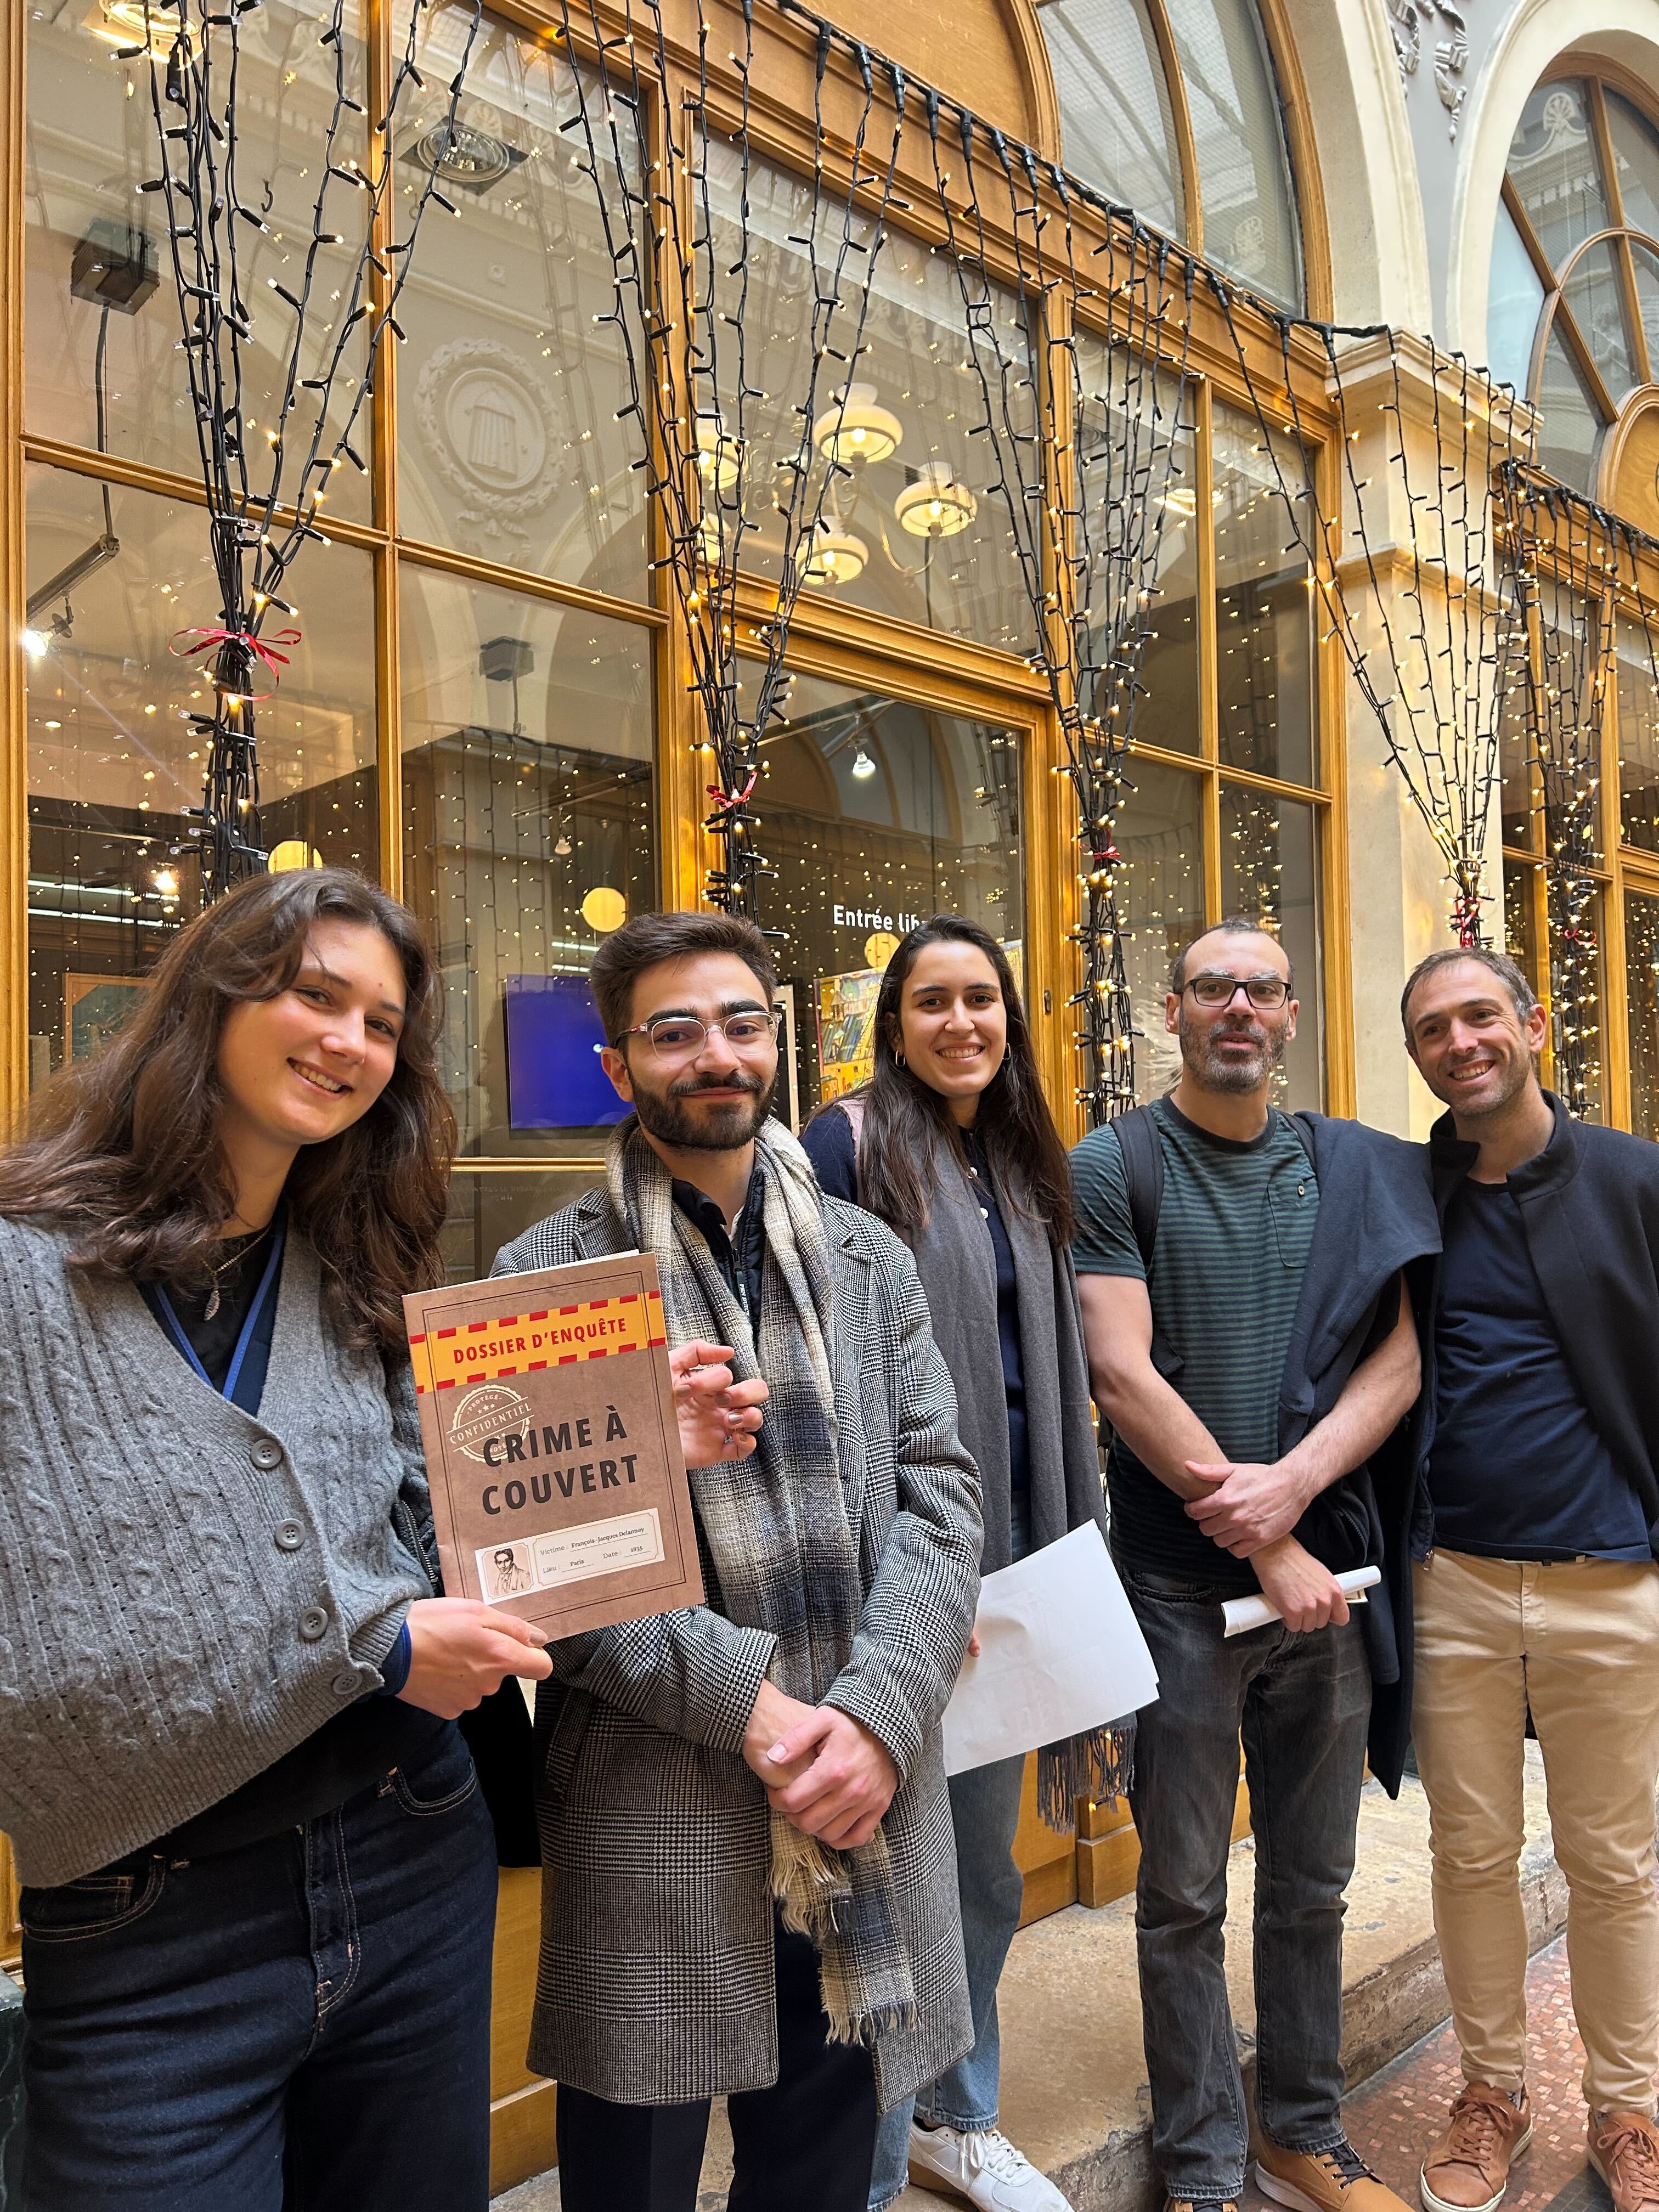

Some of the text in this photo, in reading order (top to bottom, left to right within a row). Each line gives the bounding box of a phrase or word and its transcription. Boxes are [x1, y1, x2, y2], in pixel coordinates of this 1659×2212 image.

[833, 905, 928, 933] Entrée lib
[453, 1318, 627, 1364] DOSSIER D’ENQUÊTE
[450, 1403, 532, 1444] CONFIDENTIEL
[483, 1405, 628, 1467] CRIME À
[482, 1454, 637, 1515] COUVERT
[540, 1545, 565, 1555] Victime
[571, 1533, 618, 1548] François-Jacques
